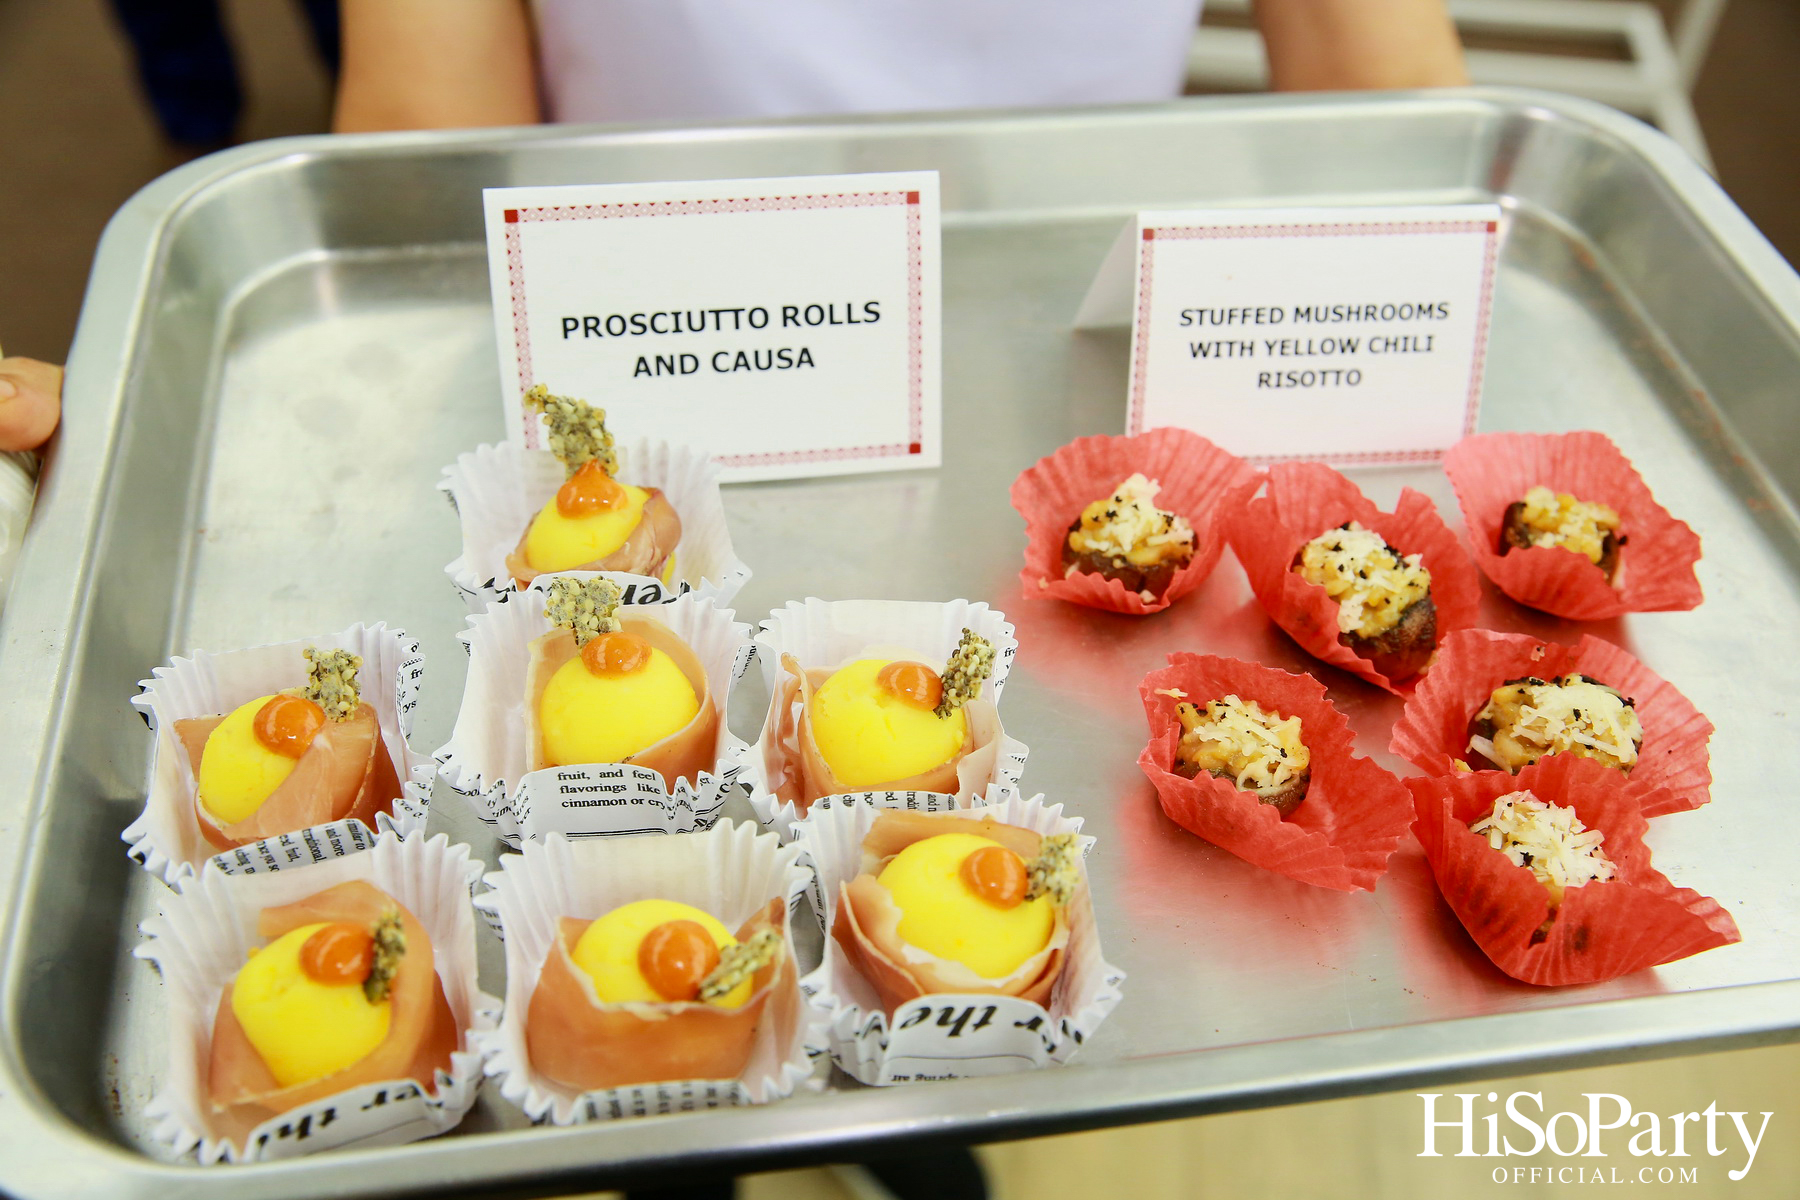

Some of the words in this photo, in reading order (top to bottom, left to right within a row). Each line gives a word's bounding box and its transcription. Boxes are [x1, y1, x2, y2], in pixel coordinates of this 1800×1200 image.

[562, 308, 769, 339] PROSCIUTTO
[782, 301, 881, 328] ROLLS
[1180, 307, 1285, 327] STUFFED
[1294, 302, 1449, 323] MUSHROOMS
[1190, 341, 1255, 359] WITH
[1265, 337, 1360, 357] YELLOW
[1368, 335, 1435, 354] CHILI
[634, 353, 699, 378] AND
[711, 347, 815, 373] CAUSA
[1258, 369, 1362, 389] RISOTTO
[557, 772, 591, 781] fruit,
[599, 769, 624, 779] and
[632, 770, 656, 781] feel
[560, 783, 627, 794] flavorings
[637, 784, 660, 794] like
[562, 798, 627, 808] cinnamon
[630, 798, 645, 806] or
[906, 791, 920, 811] tradit
[900, 1005, 998, 1038] the
